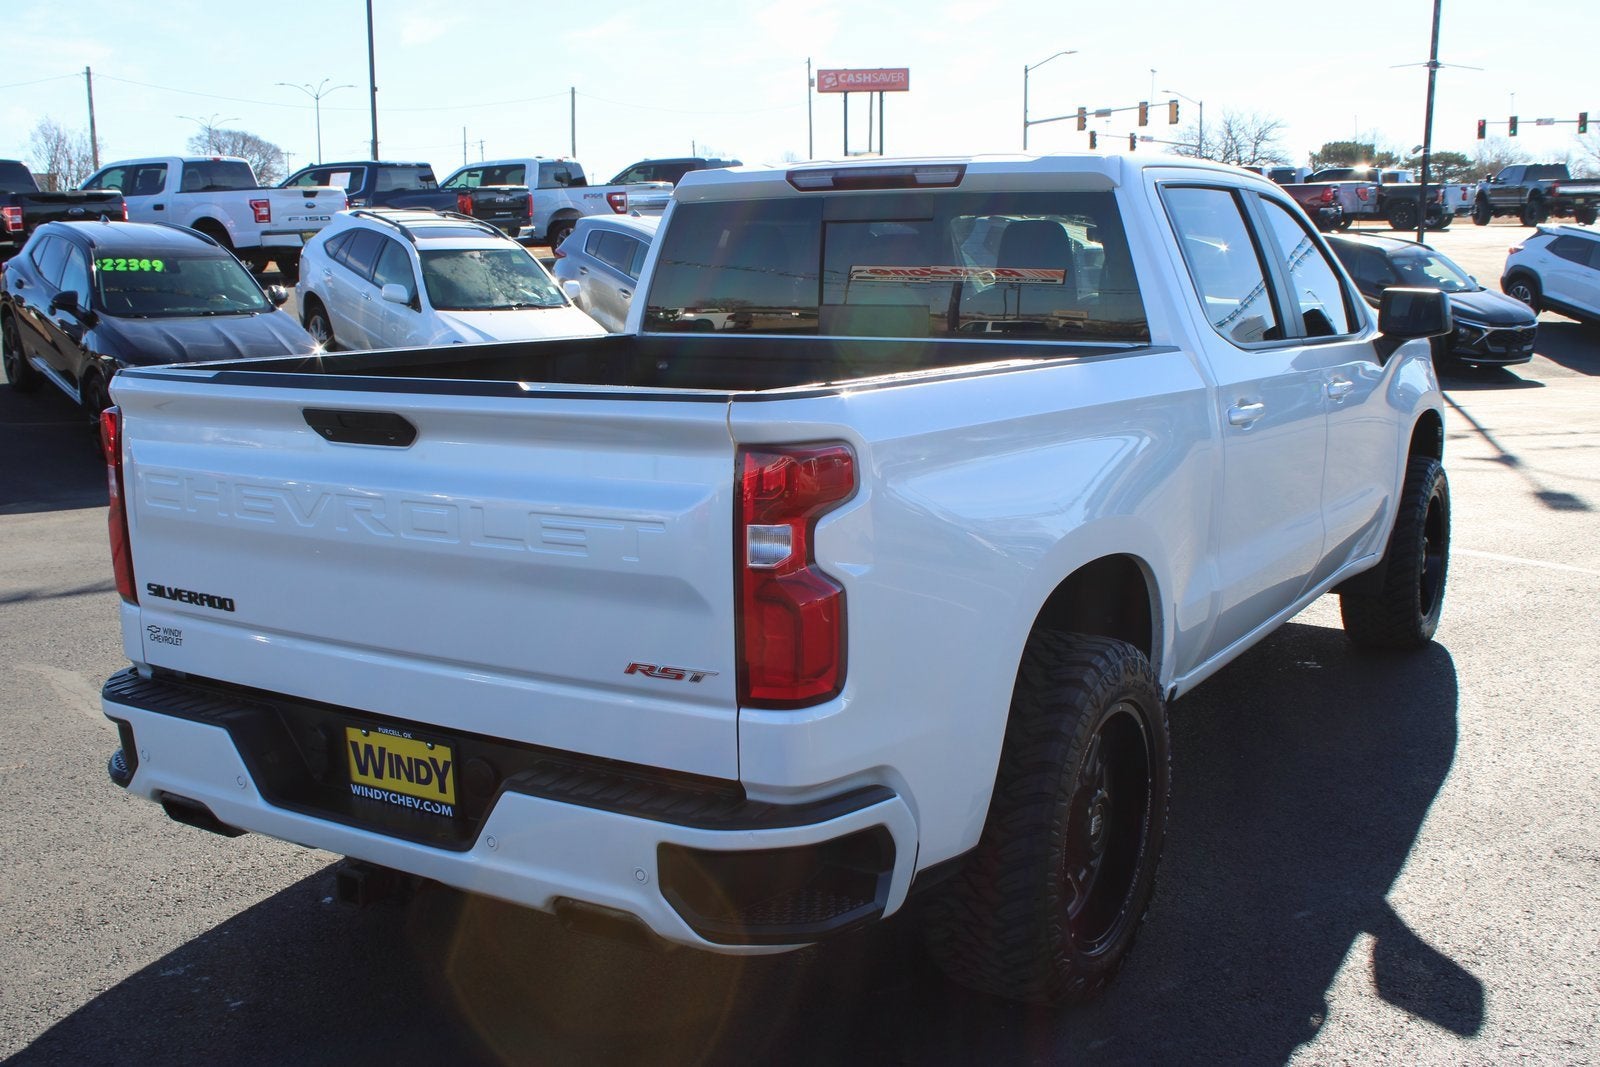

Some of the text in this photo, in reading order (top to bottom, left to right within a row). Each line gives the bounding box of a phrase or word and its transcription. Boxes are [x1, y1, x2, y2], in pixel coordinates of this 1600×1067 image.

[143, 472, 666, 562] CHEVROLET
[146, 582, 235, 612] SILVERADO
[149, 633, 183, 646] CHEVROLET
[162, 627, 183, 638] WINDY
[623, 661, 720, 683] RST
[349, 740, 452, 795] WINDY
[350, 783, 453, 817] WINDYCHEV.COM
